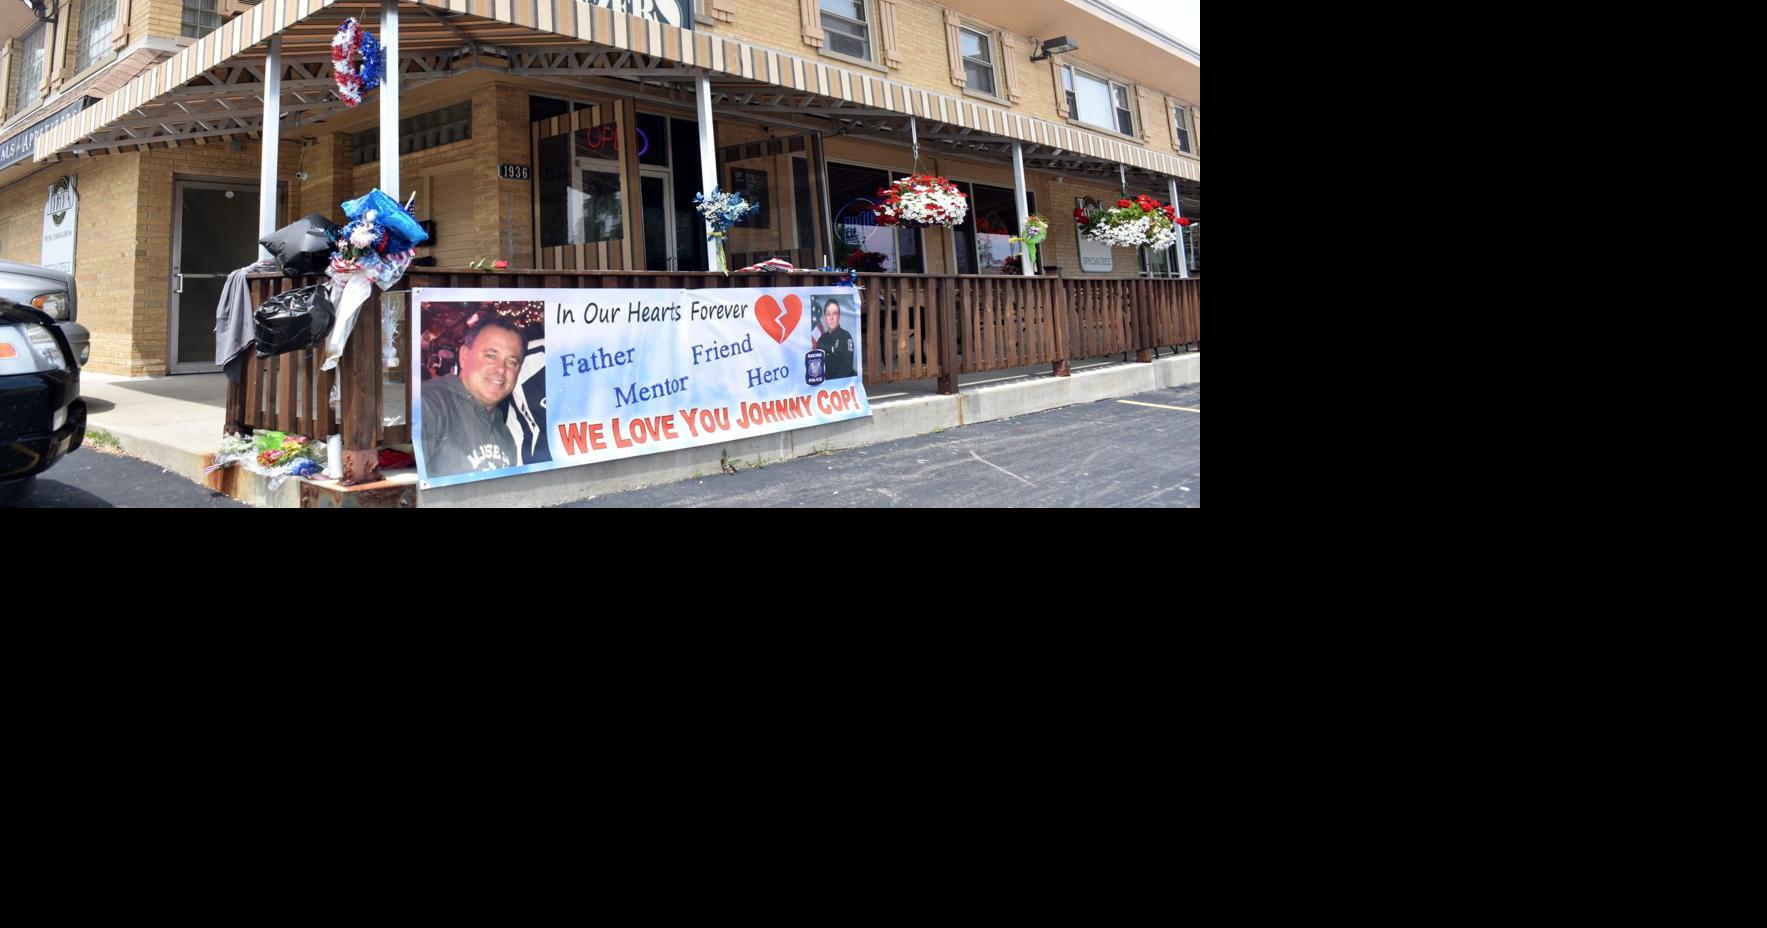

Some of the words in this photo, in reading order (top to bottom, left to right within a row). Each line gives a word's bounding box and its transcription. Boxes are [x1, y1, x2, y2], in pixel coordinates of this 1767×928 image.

[504, 165, 528, 179] 1936
[556, 303, 575, 325] In
[584, 302, 621, 324] Our
[628, 301, 682, 323] Hearts
[691, 300, 748, 321] Forever
[560, 347, 635, 377] Father
[691, 333, 753, 365] Friend
[613, 375, 689, 408] Mentor
[746, 365, 790, 389] Hero
[558, 421, 608, 456] WE
[612, 414, 680, 449] LOVE
[679, 407, 732, 438] YOU
[736, 394, 813, 430] JOHNNY
[816, 385, 861, 416] COP!
